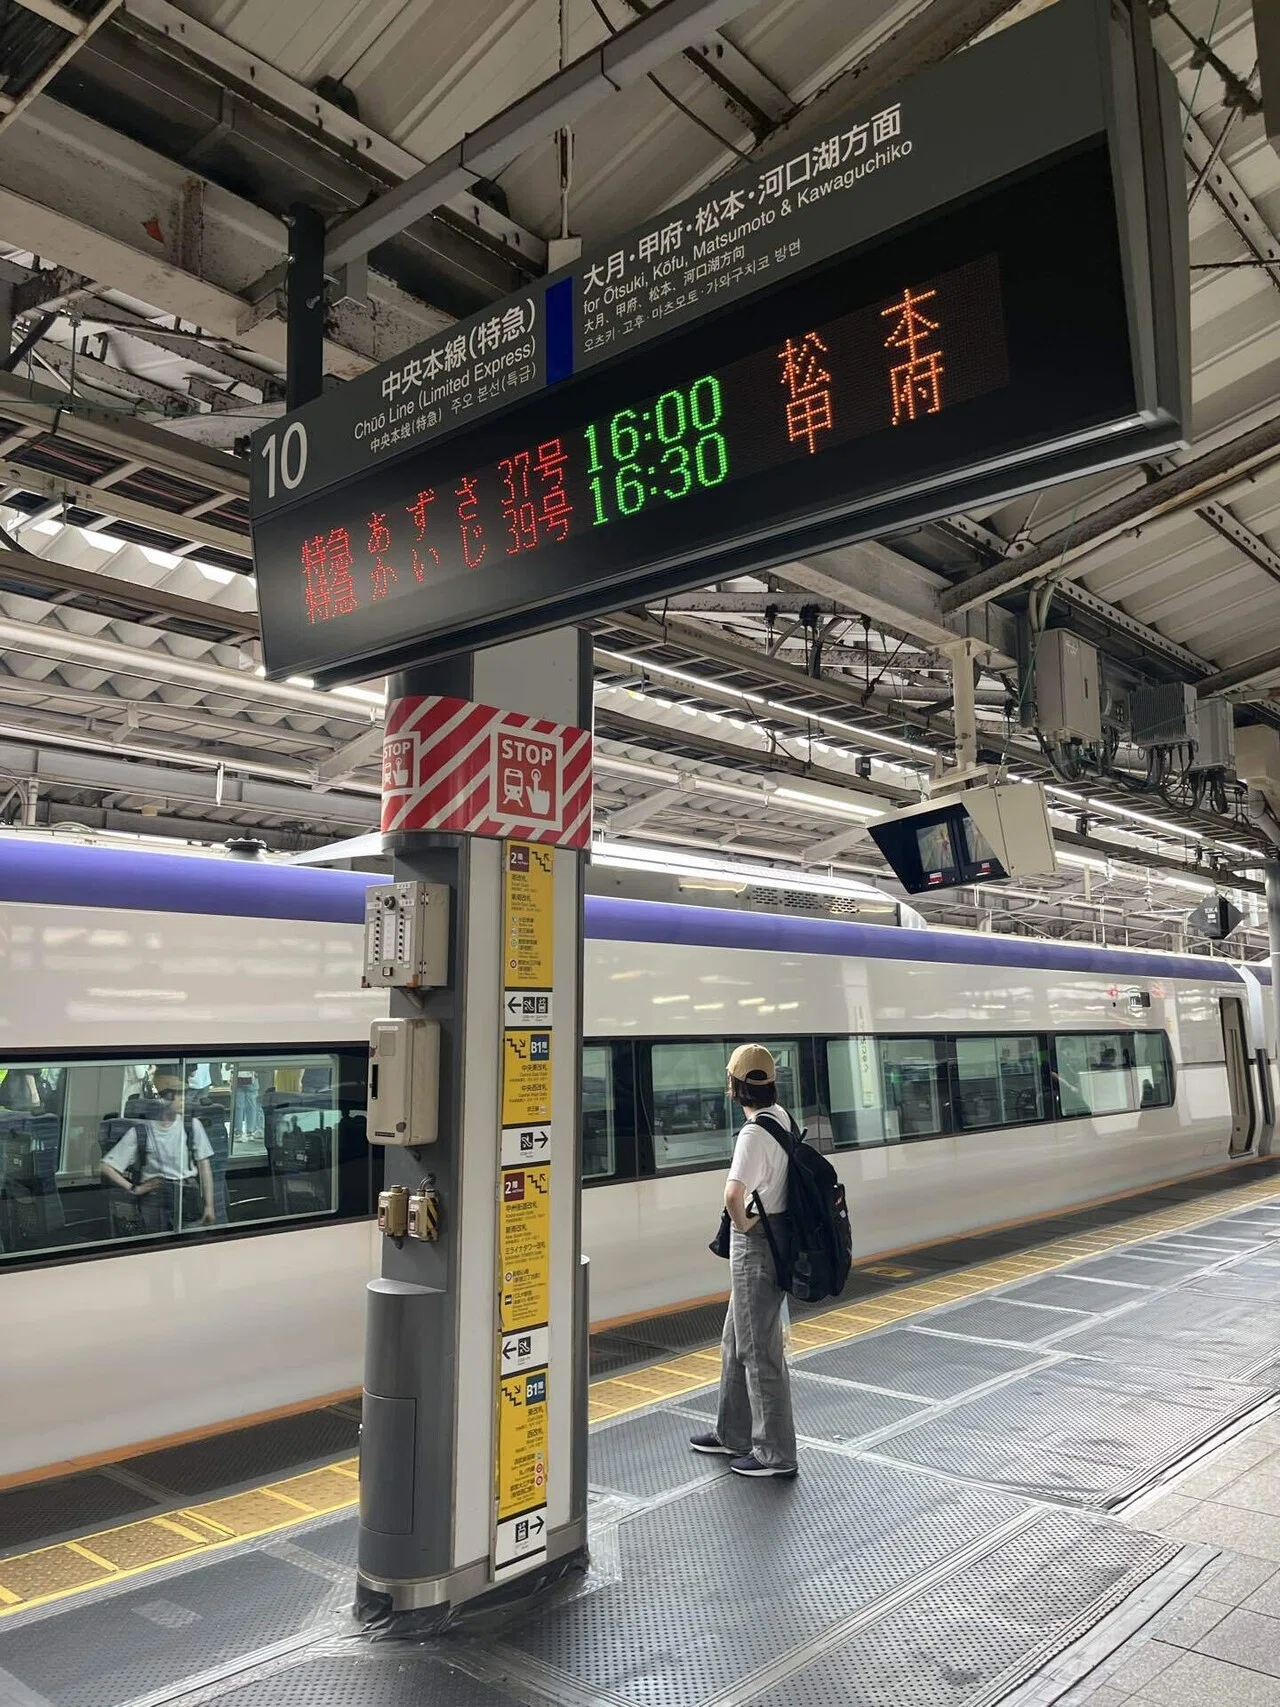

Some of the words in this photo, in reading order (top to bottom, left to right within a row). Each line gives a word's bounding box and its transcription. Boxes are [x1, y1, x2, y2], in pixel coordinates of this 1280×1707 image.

[583, 296, 599, 315] for
[603, 273, 649, 305] Ōtsuki,
[653, 252, 689, 283] Kōfu,
[693, 208, 776, 259] Matsumoto
[780, 199, 793, 216] &
[797, 140, 912, 208] Kawaguchiko
[774, 237, 801, 265] 방면
[353, 413, 386, 441] Chūō
[388, 399, 415, 425] Line
[418, 379, 470, 416] (Limited
[474, 335, 536, 385] Express)
[380, 297, 536, 403] 中央本線(特急)
[261, 420, 308, 499] 10
[366, 475, 479, 554] あずさ
[498, 438, 568, 505] 37号
[584, 375, 722, 474] 16:00
[777, 288, 941, 398] 松本
[369, 407, 443, 454] 中央本线(特急)
[369, 523, 487, 601] かいじ
[501, 486, 573, 555] 39号
[587, 430, 729, 526] 16:30
[786, 350, 945, 454] 甲府
[384, 742, 411, 759] STOP
[501, 739, 553, 767] STOP
